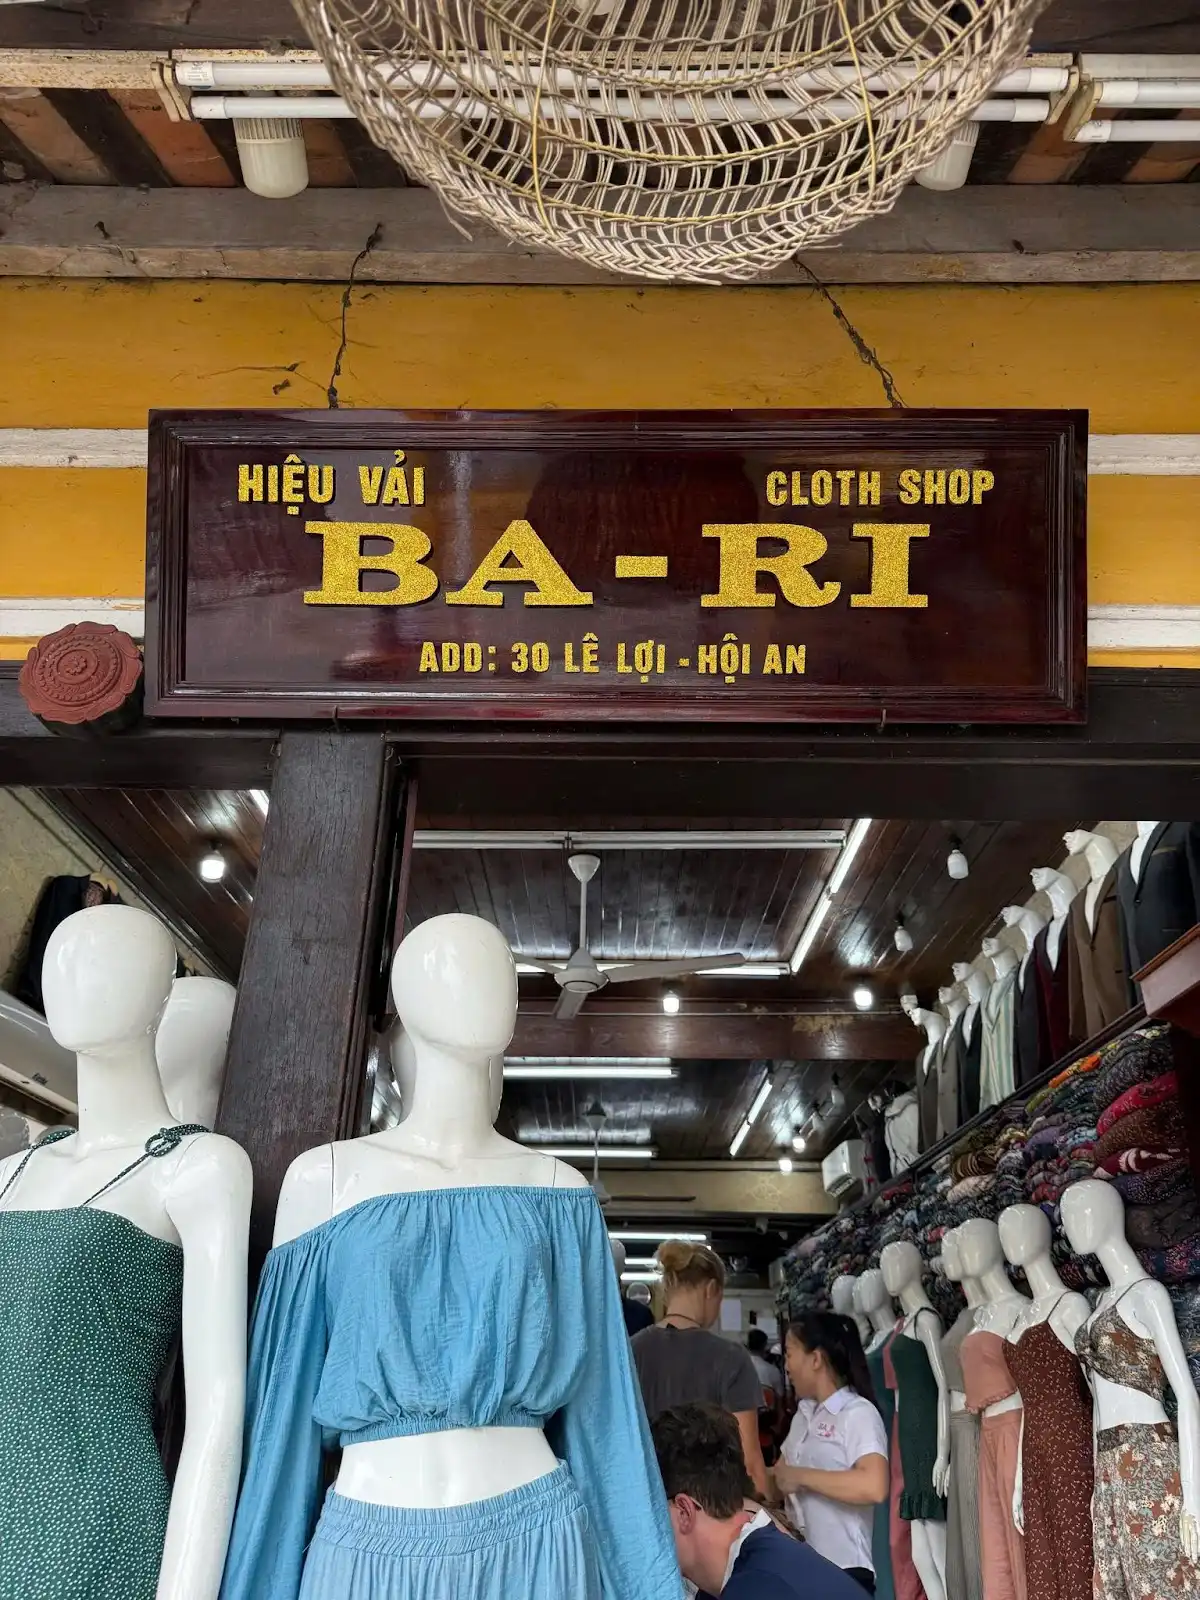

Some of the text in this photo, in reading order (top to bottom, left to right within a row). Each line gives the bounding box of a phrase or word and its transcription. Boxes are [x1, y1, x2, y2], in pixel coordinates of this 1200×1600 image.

[237, 449, 426, 515] HIỆU VẢI
[766, 469, 995, 506] CLOTH SHOP
[418, 642, 497, 673] ADD:
[511, 642, 550, 673] 30
[564, 632, 600, 673] LÊ
[616, 640, 666, 683] LỢI
[697, 633, 751, 683] HỘI
[762, 644, 807, 674] AN
